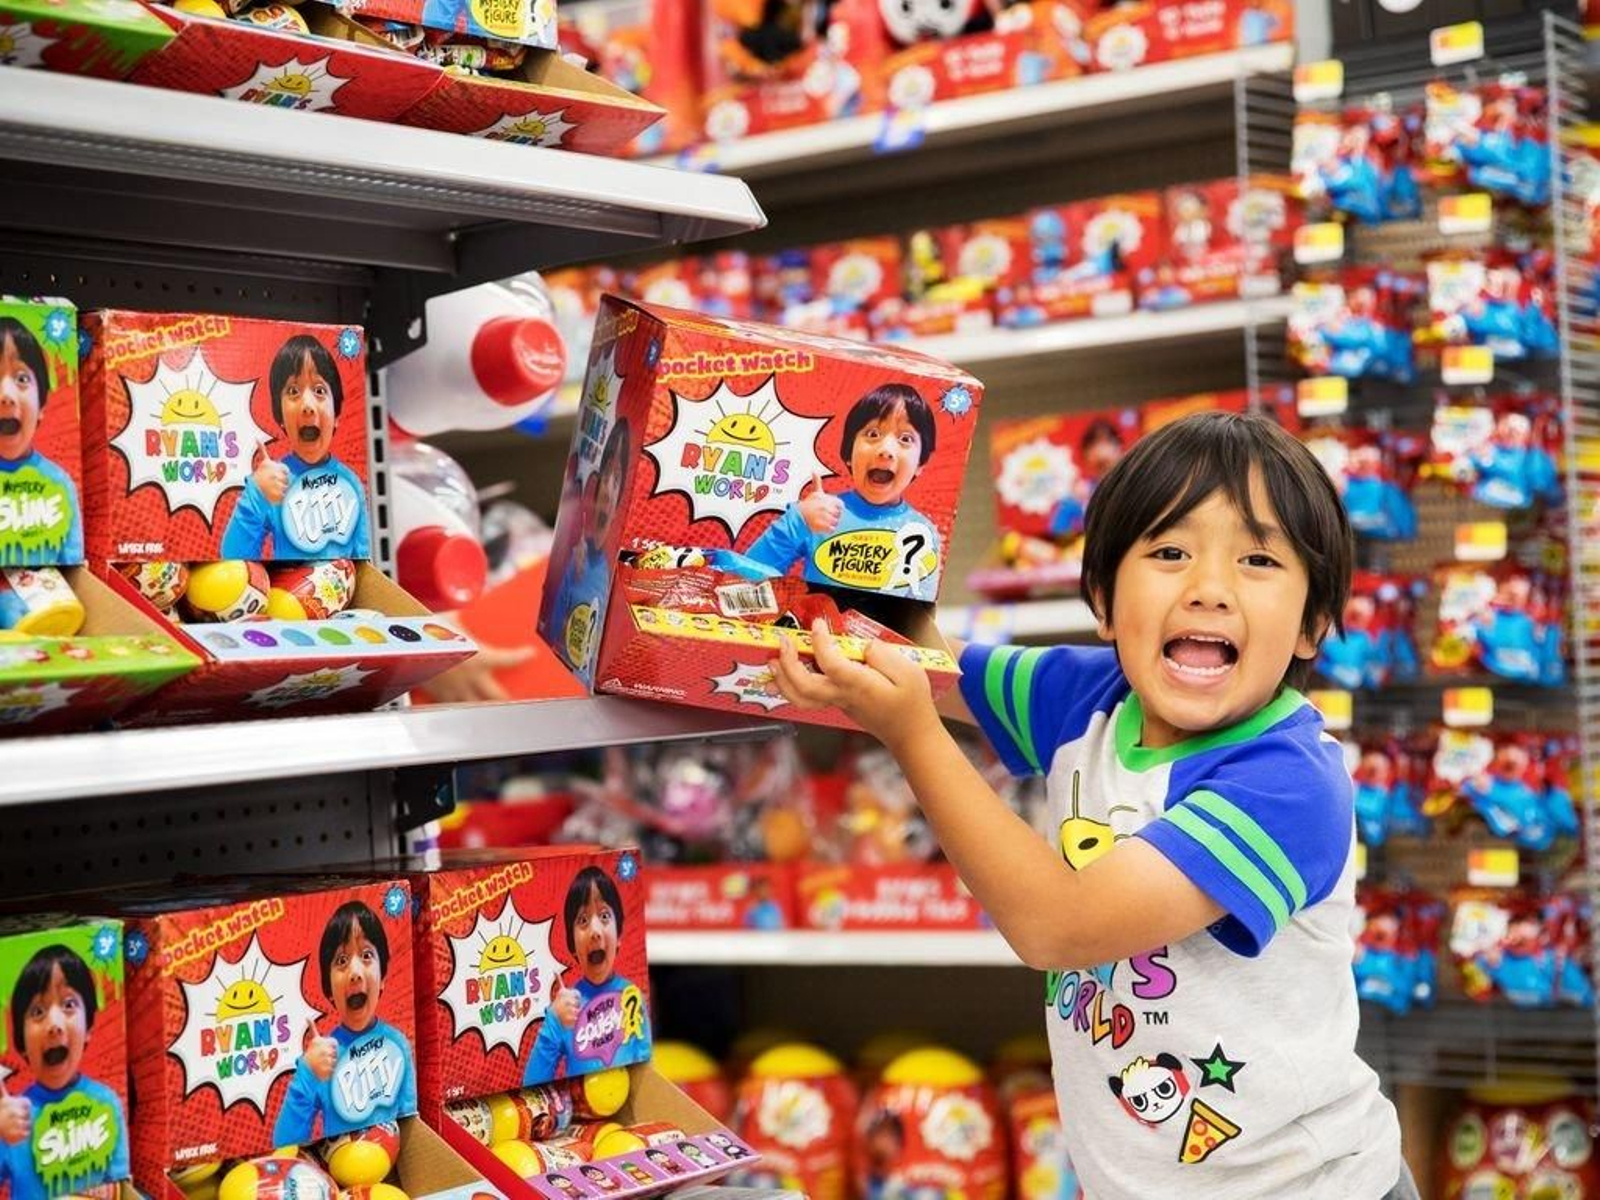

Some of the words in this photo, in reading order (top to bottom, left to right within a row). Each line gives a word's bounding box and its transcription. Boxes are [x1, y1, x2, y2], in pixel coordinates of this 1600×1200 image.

[484, 9, 518, 24] FIGURE
[655, 350, 737, 382] pocket
[738, 349, 814, 373] watch
[145, 428, 240, 459] RYAN'S
[161, 459, 227, 484] WORLD
[680, 442, 791, 485] RYAN'S
[694, 474, 770, 504] WORLD
[829, 540, 893, 561] MYSTERY
[832, 557, 882, 576] FIGURE
[902, 534, 926, 575] ?
[225, 899, 283, 940] watch
[465, 967, 542, 1006] RYAN'S
[479, 997, 532, 1026] WORLD
[1142, 1011, 1169, 1025] TM
[200, 1013, 291, 1057] RYAN'S
[216, 1047, 279, 1080] WORLD
[37, 1111, 110, 1165] SLIME
